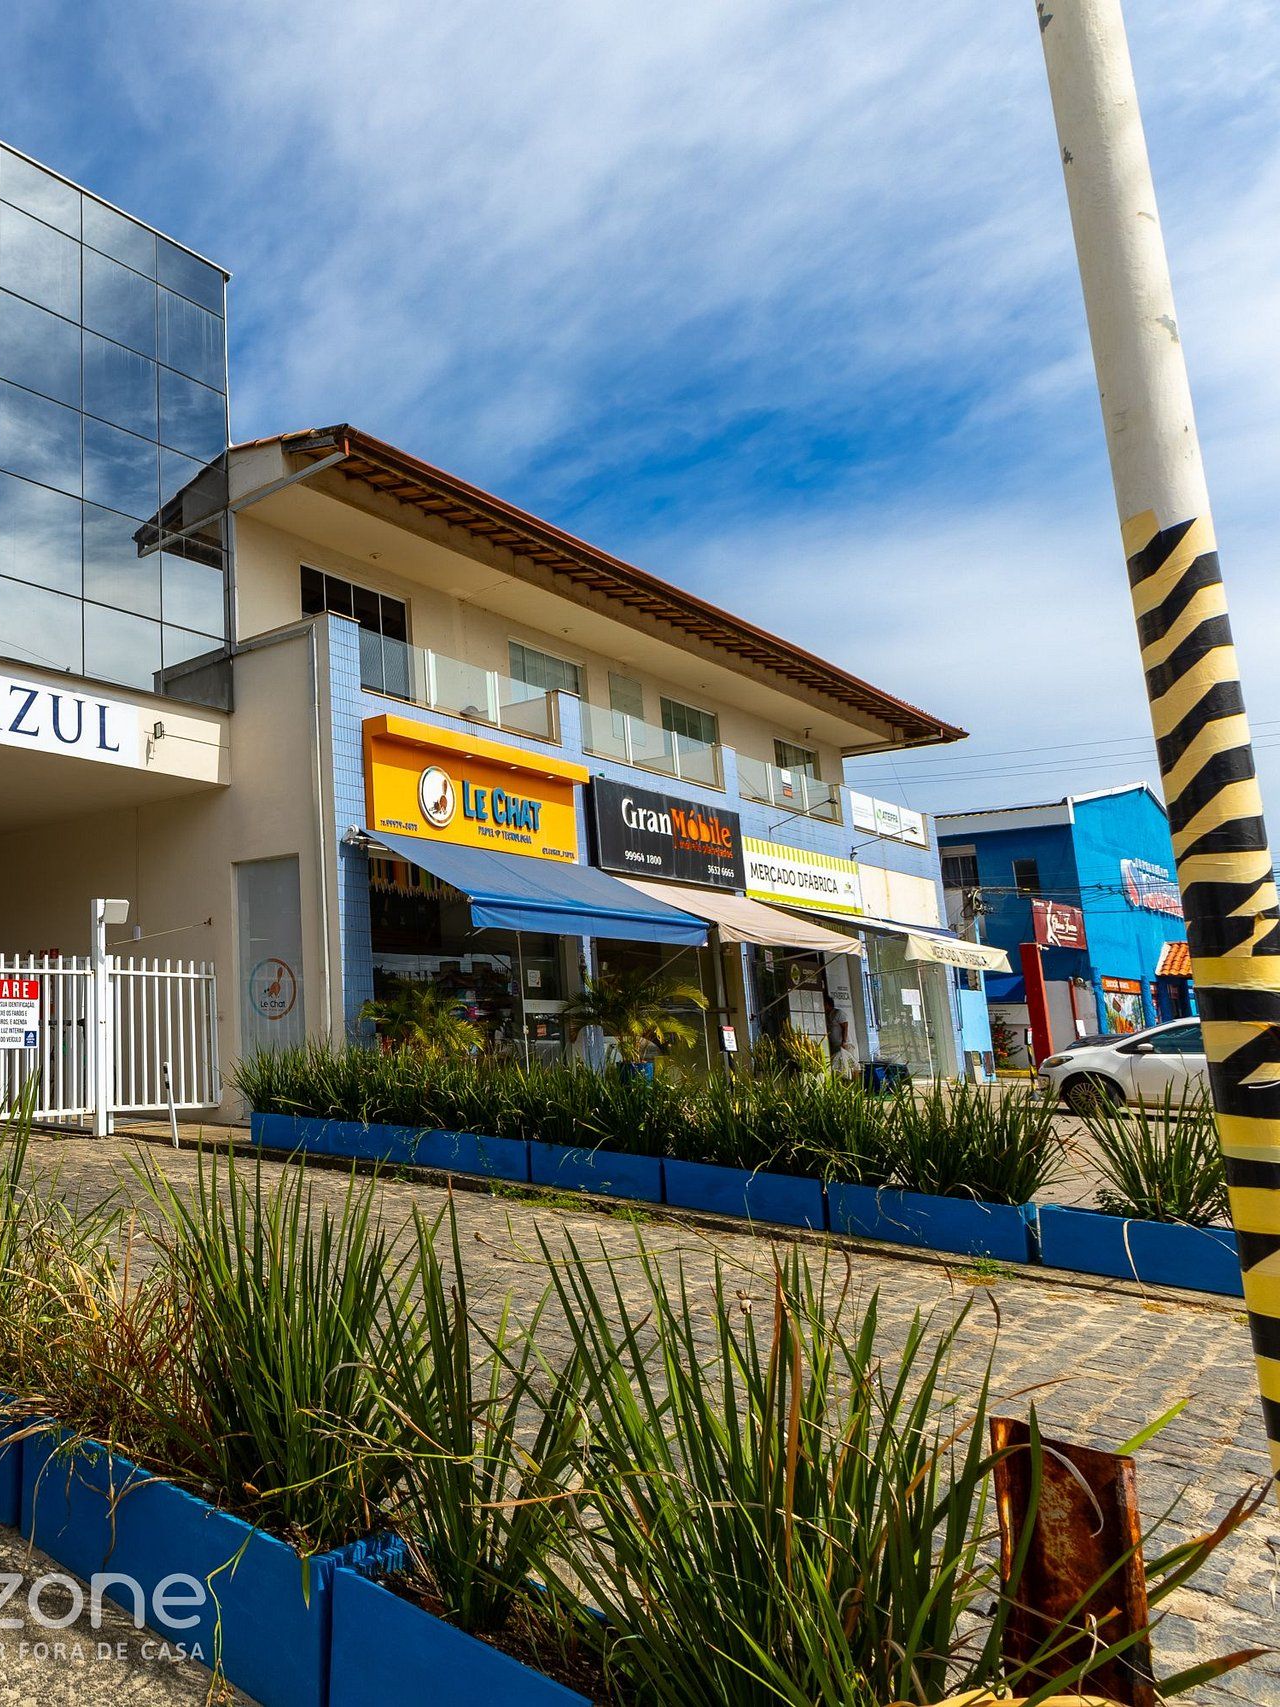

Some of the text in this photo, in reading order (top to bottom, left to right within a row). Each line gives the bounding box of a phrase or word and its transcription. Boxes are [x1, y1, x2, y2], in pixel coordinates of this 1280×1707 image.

[462, 780, 489, 820] LE
[750, 862, 839, 894] MERCADO DFÁBRICA
